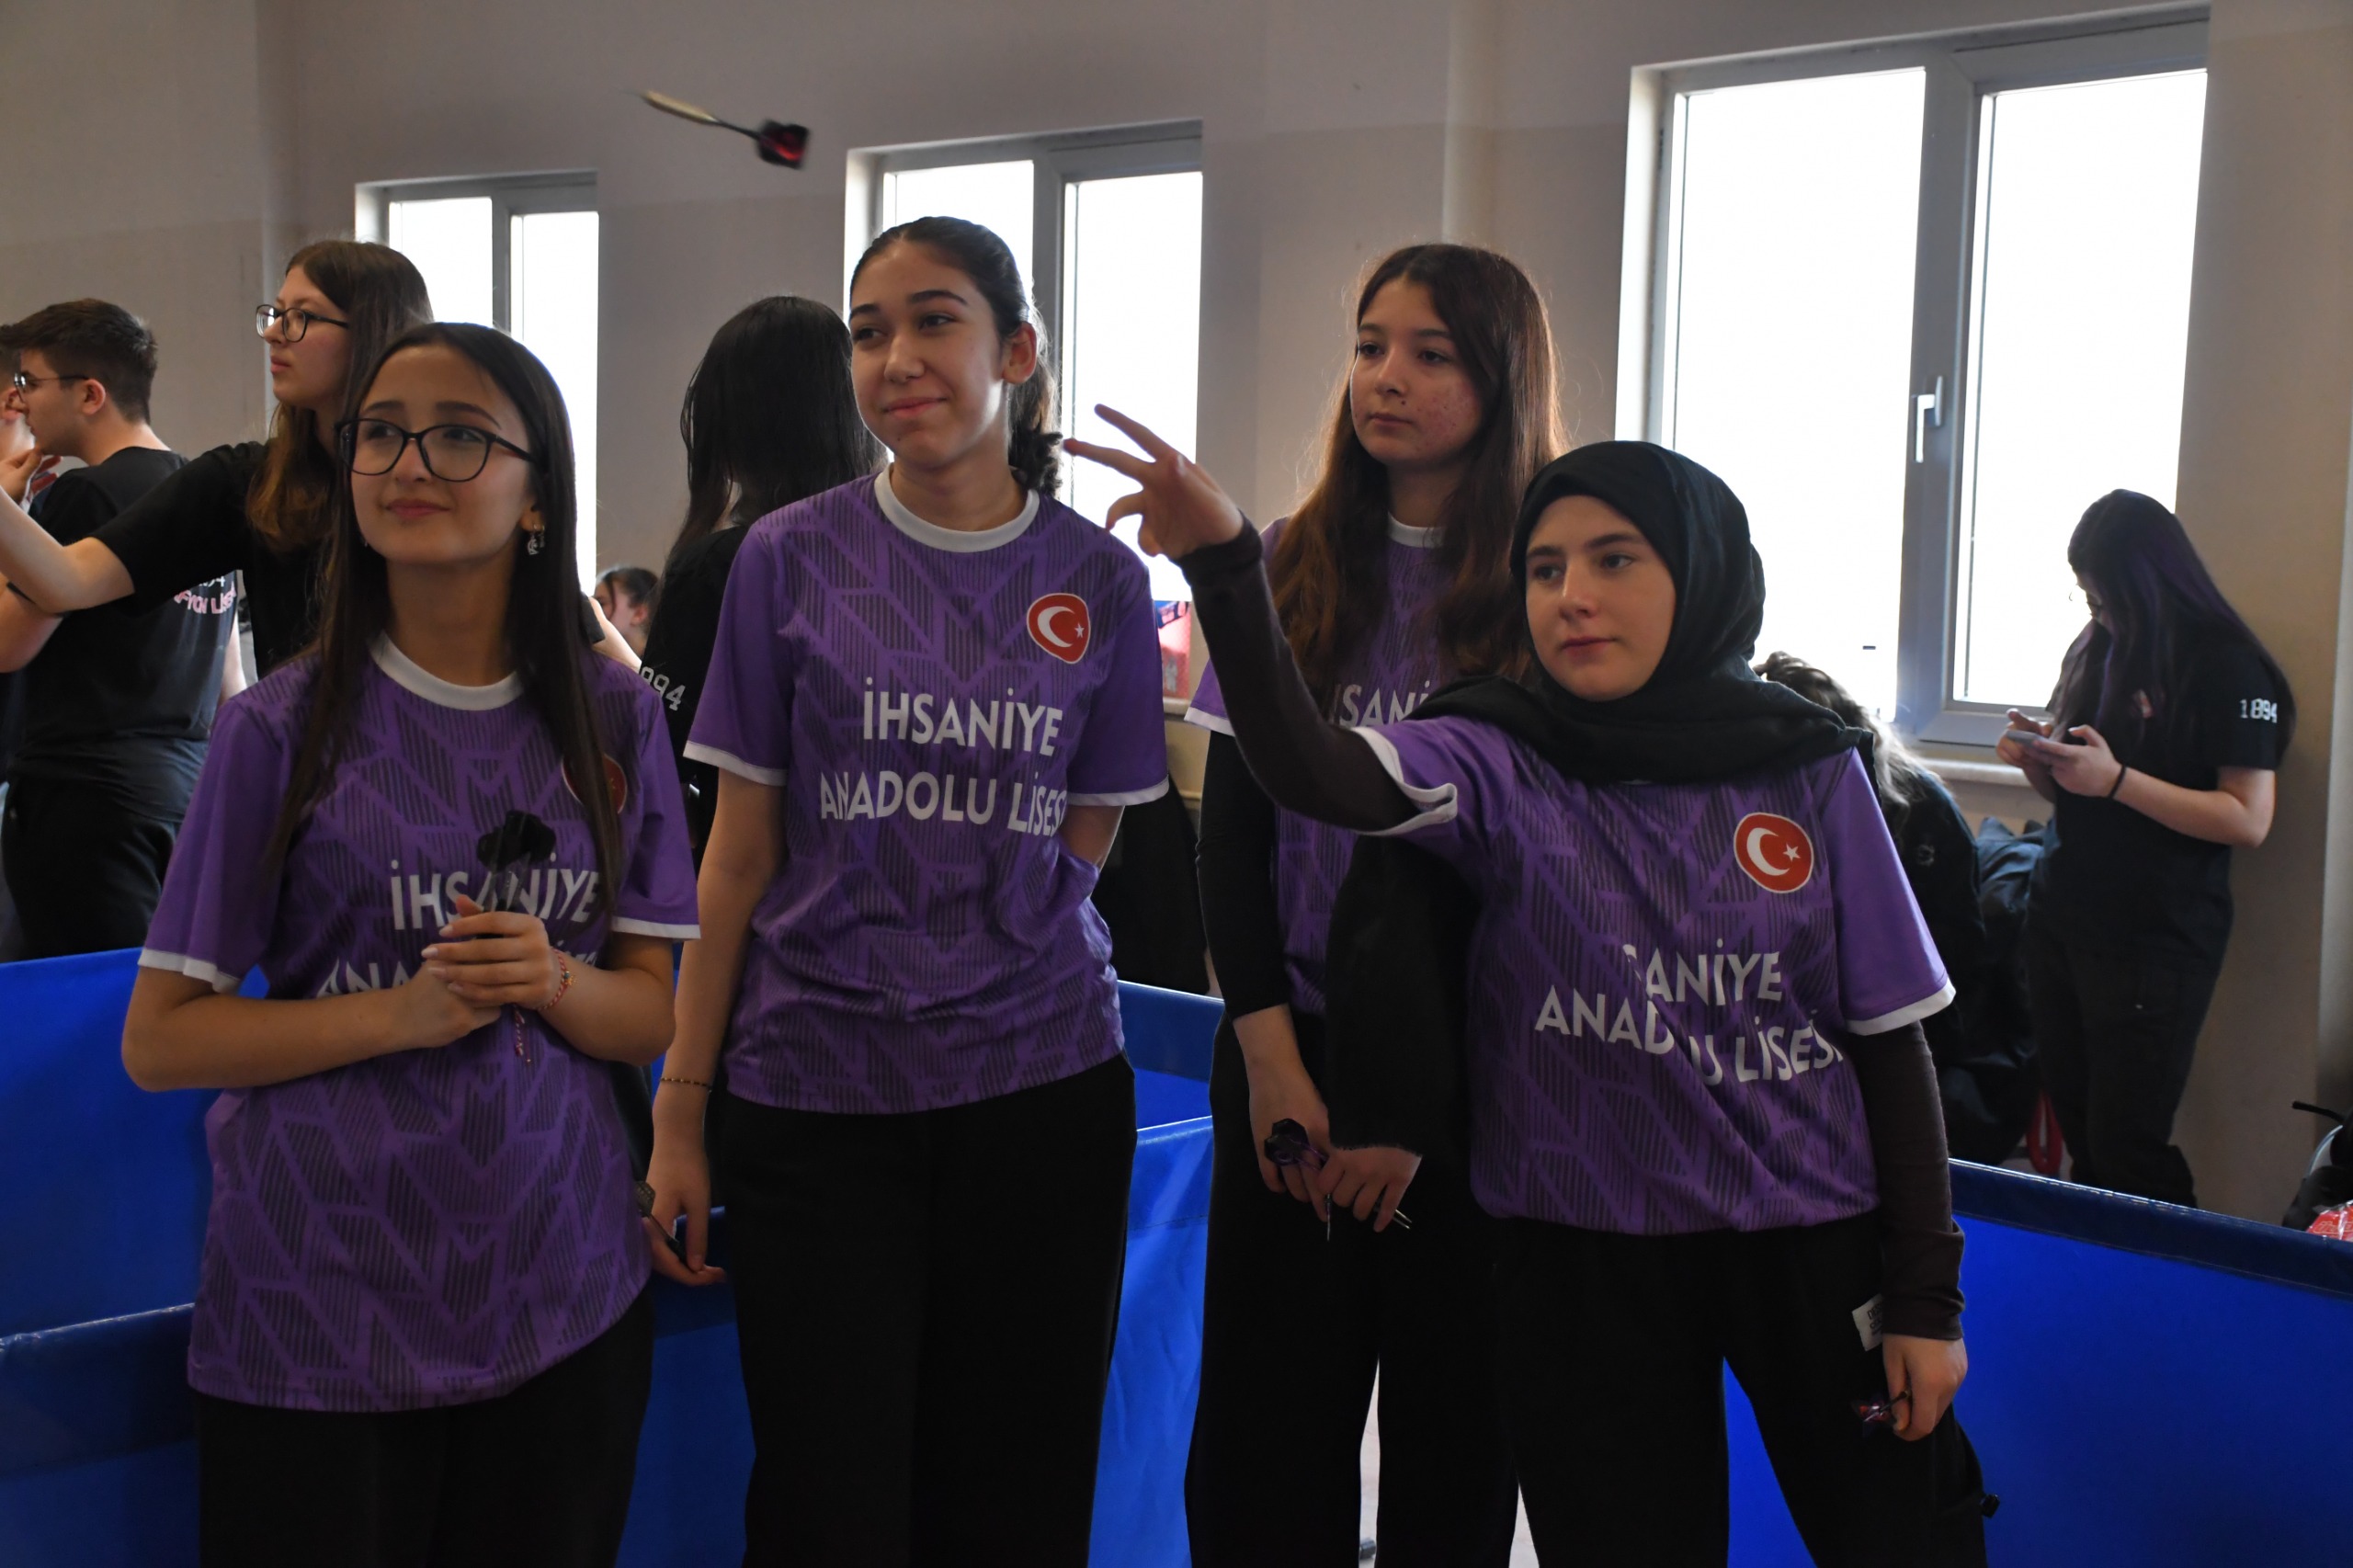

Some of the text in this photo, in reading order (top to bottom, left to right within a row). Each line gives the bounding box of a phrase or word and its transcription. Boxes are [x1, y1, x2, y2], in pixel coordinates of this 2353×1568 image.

[863, 676, 1063, 756] İHSANİYE
[2239, 698, 2278, 723] 1894
[821, 770, 1068, 838] ANADOLU LİSES
